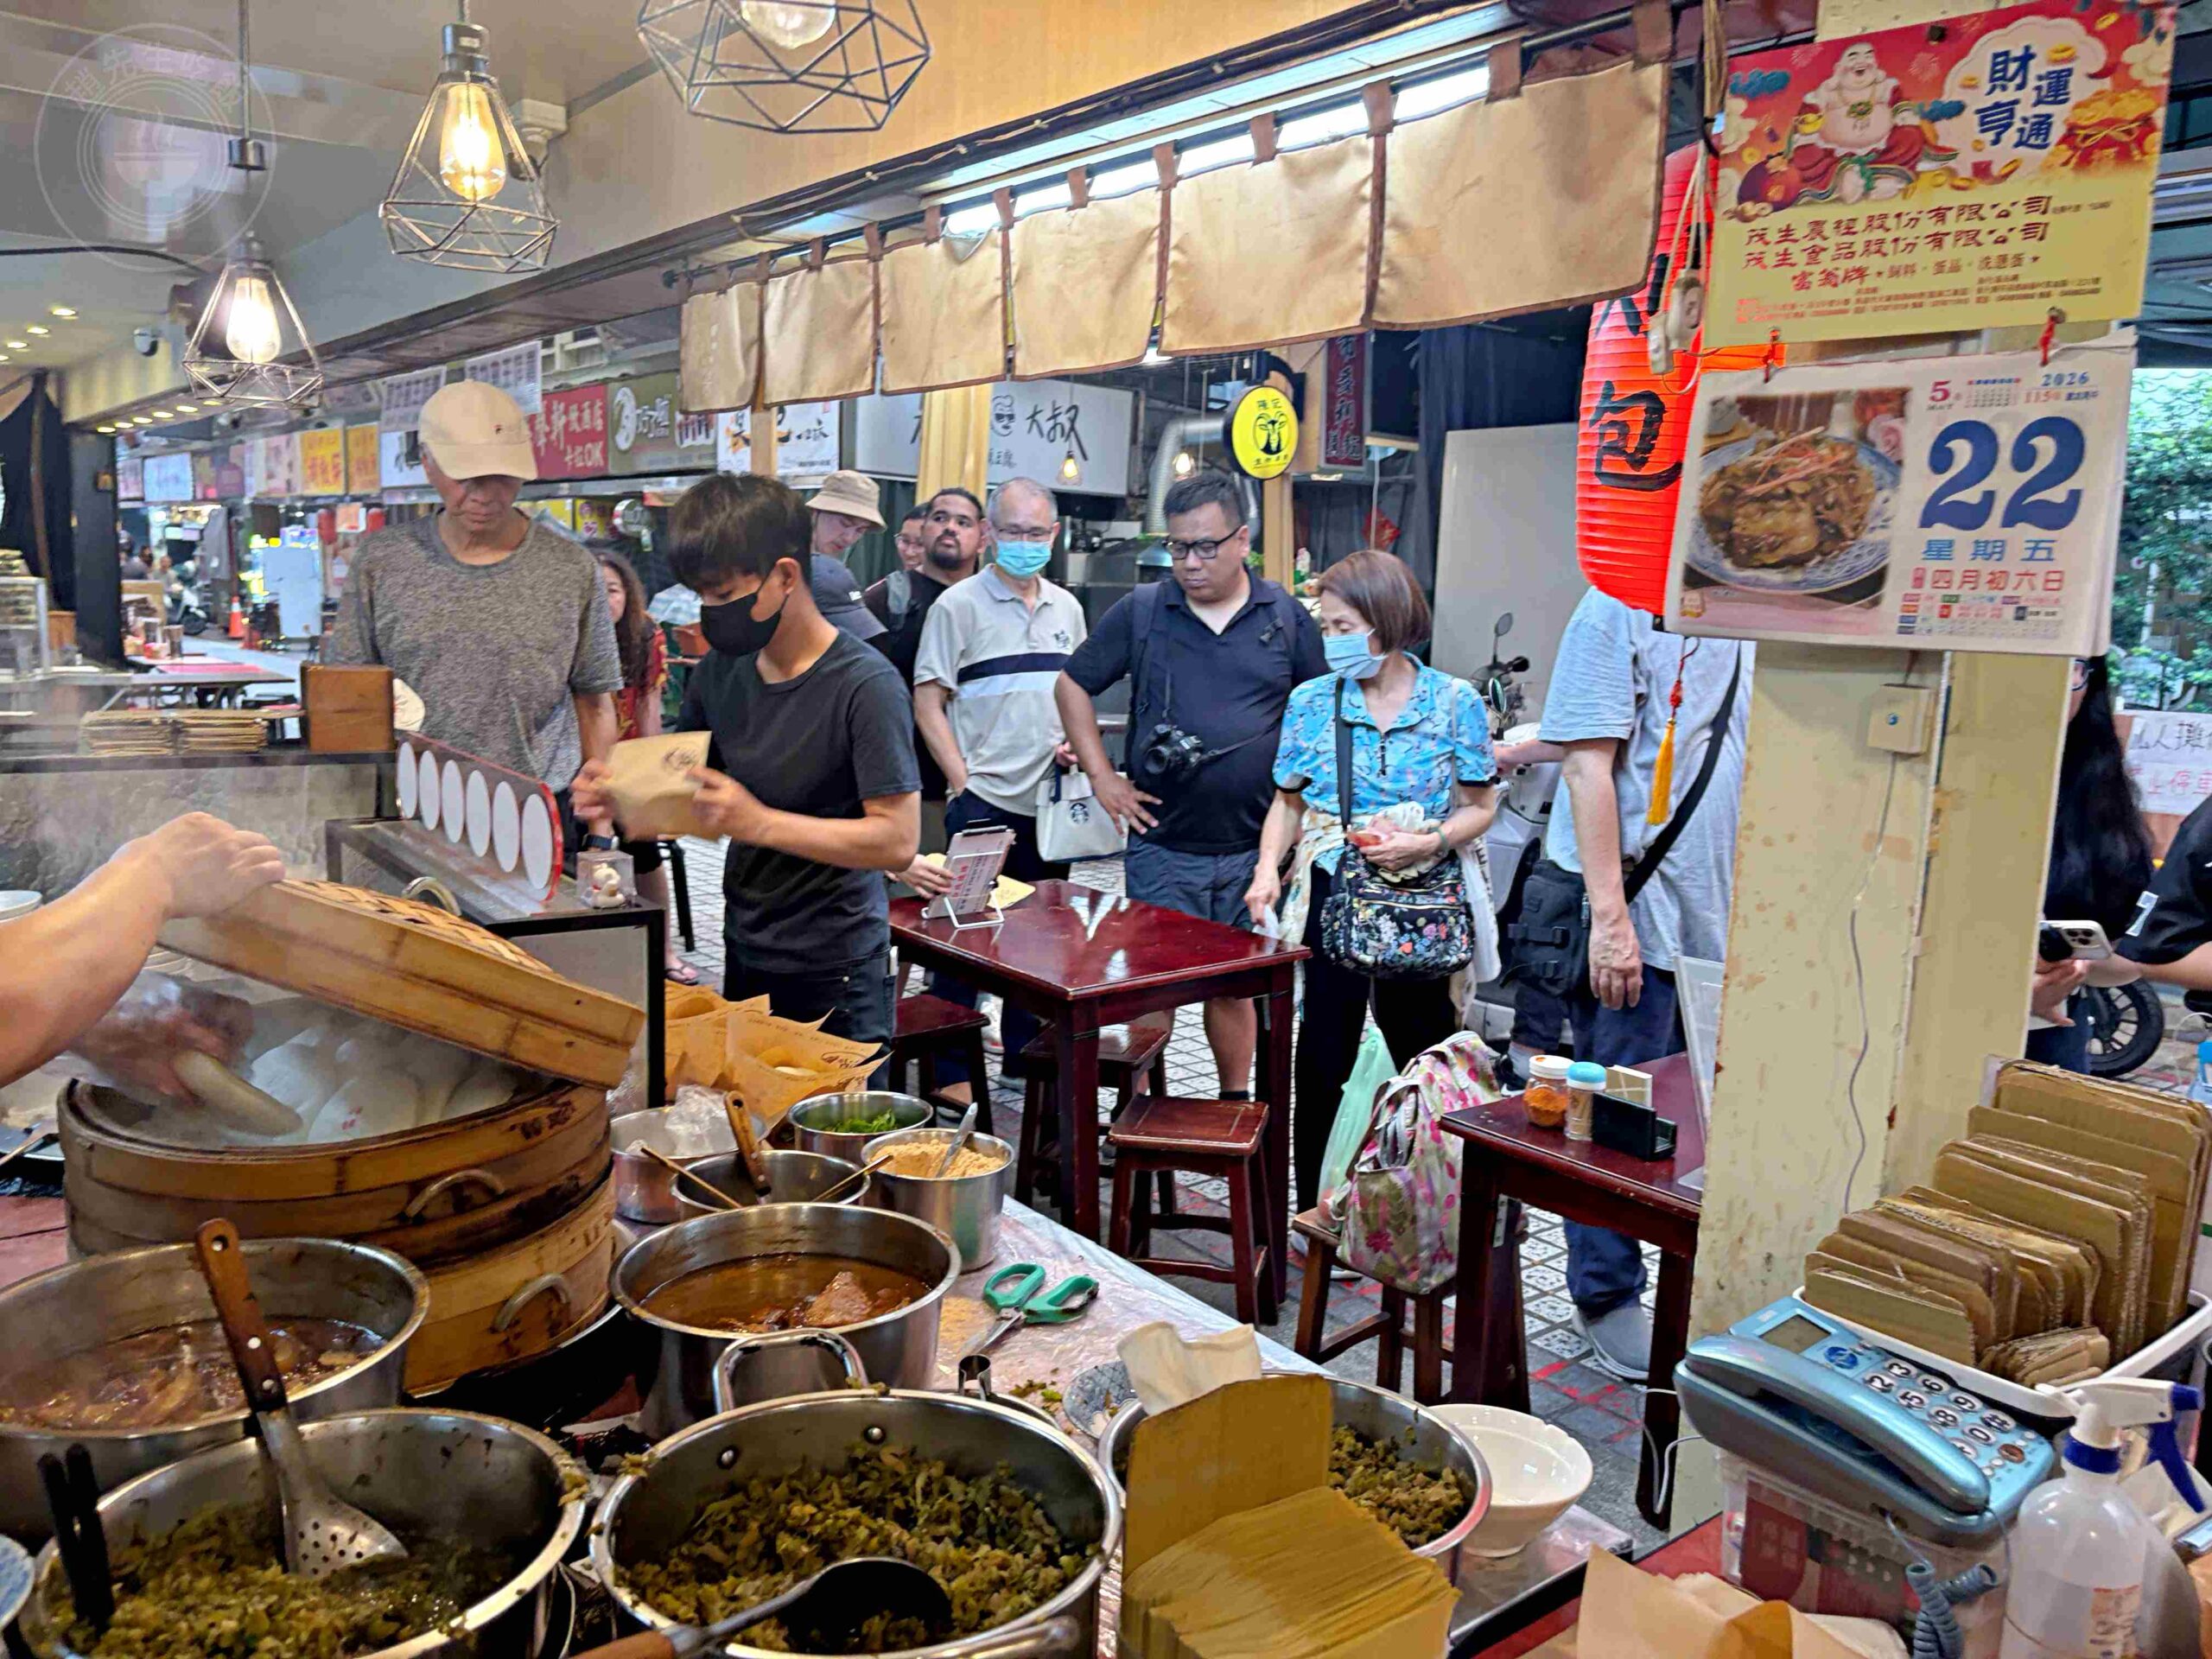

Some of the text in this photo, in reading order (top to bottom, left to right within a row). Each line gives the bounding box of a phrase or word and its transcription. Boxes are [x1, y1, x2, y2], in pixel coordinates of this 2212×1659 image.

[1985, 44, 2073, 107] 財運
[1974, 98, 2054, 149] 亨通
[1929, 380, 1951, 402] 5
[2041, 372, 2089, 387] 2026
[1026, 399, 1088, 461] 大叔
[1918, 416, 2085, 531] 22
[1921, 538, 2058, 562] 星期五
[1930, 569, 2065, 591] 四月初六日
